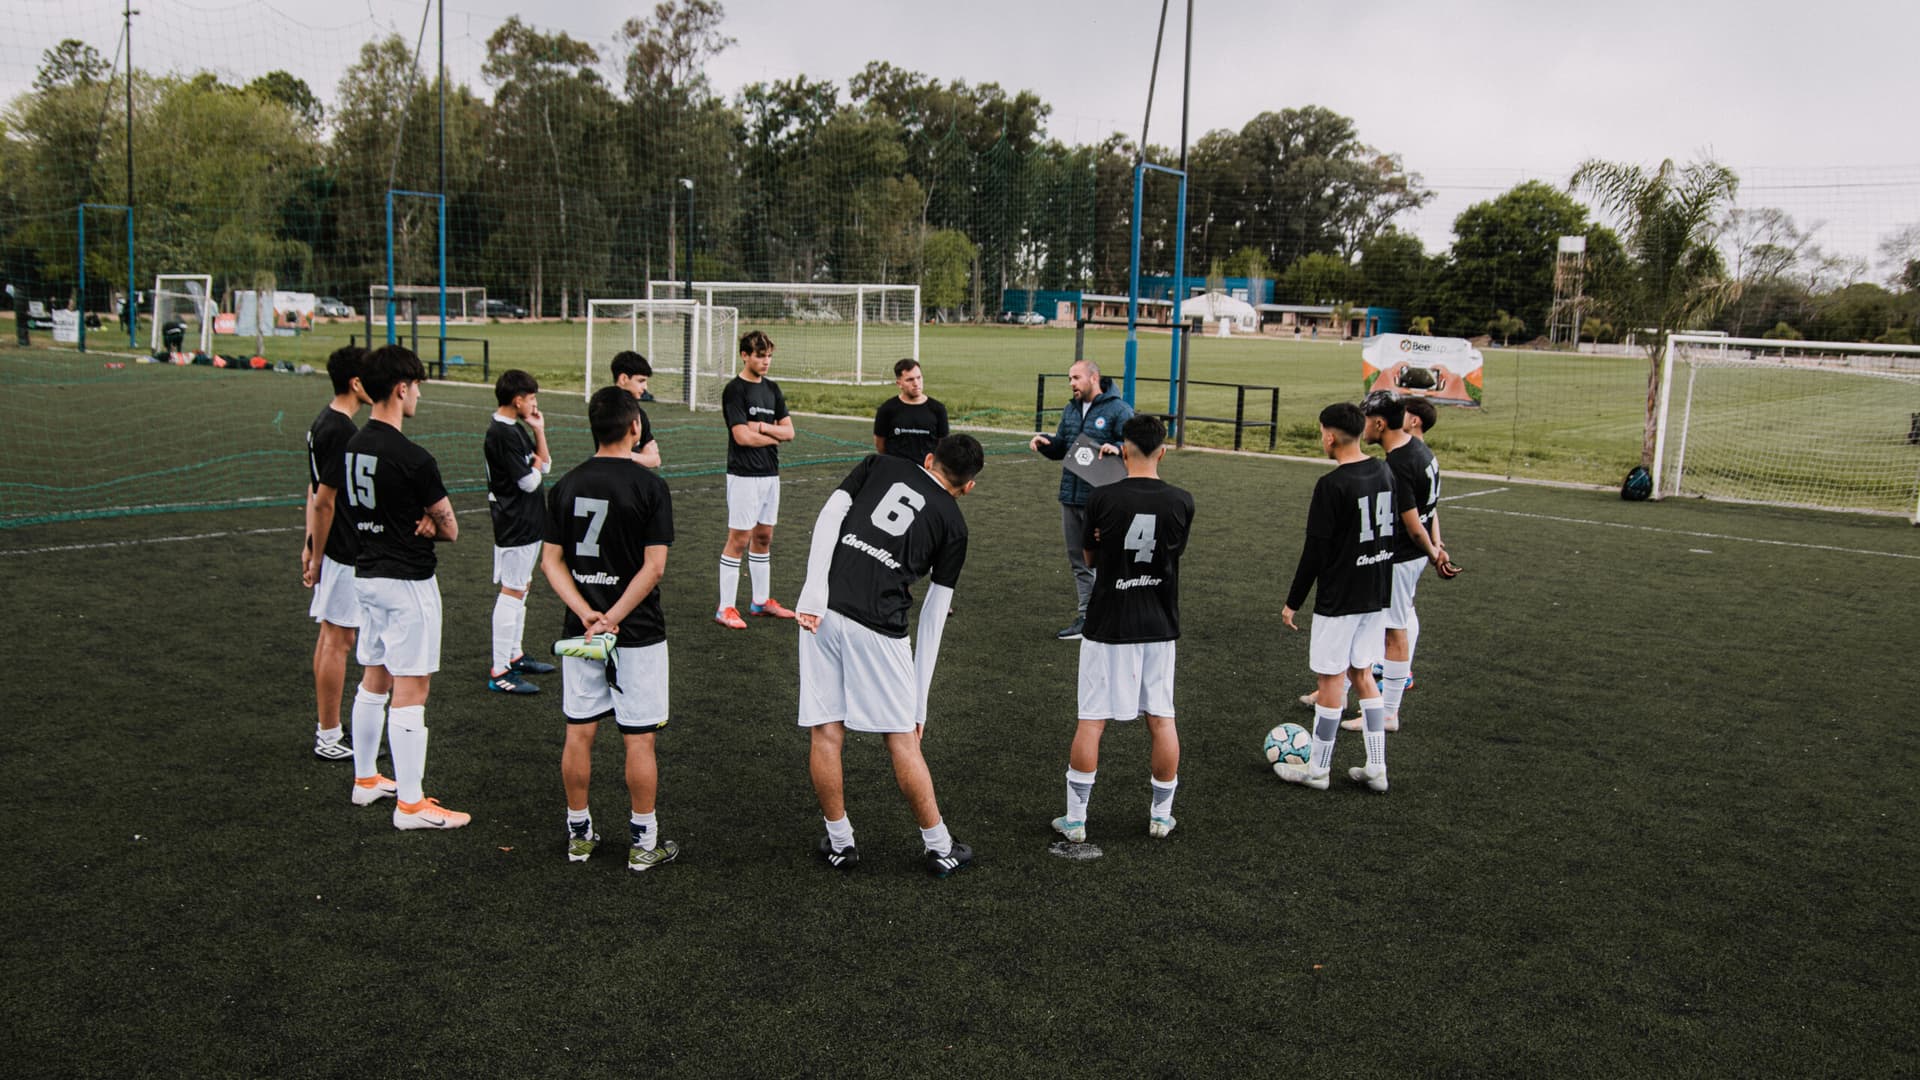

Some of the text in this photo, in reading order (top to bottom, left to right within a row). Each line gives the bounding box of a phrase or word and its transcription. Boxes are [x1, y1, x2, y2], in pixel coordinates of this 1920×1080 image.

[345, 452, 378, 510] 15
[574, 497, 609, 557] 7
[871, 482, 926, 536] 6
[1358, 491, 1394, 543] 14
[842, 533, 901, 569] Chevallier
[1124, 514, 1156, 563] 4
